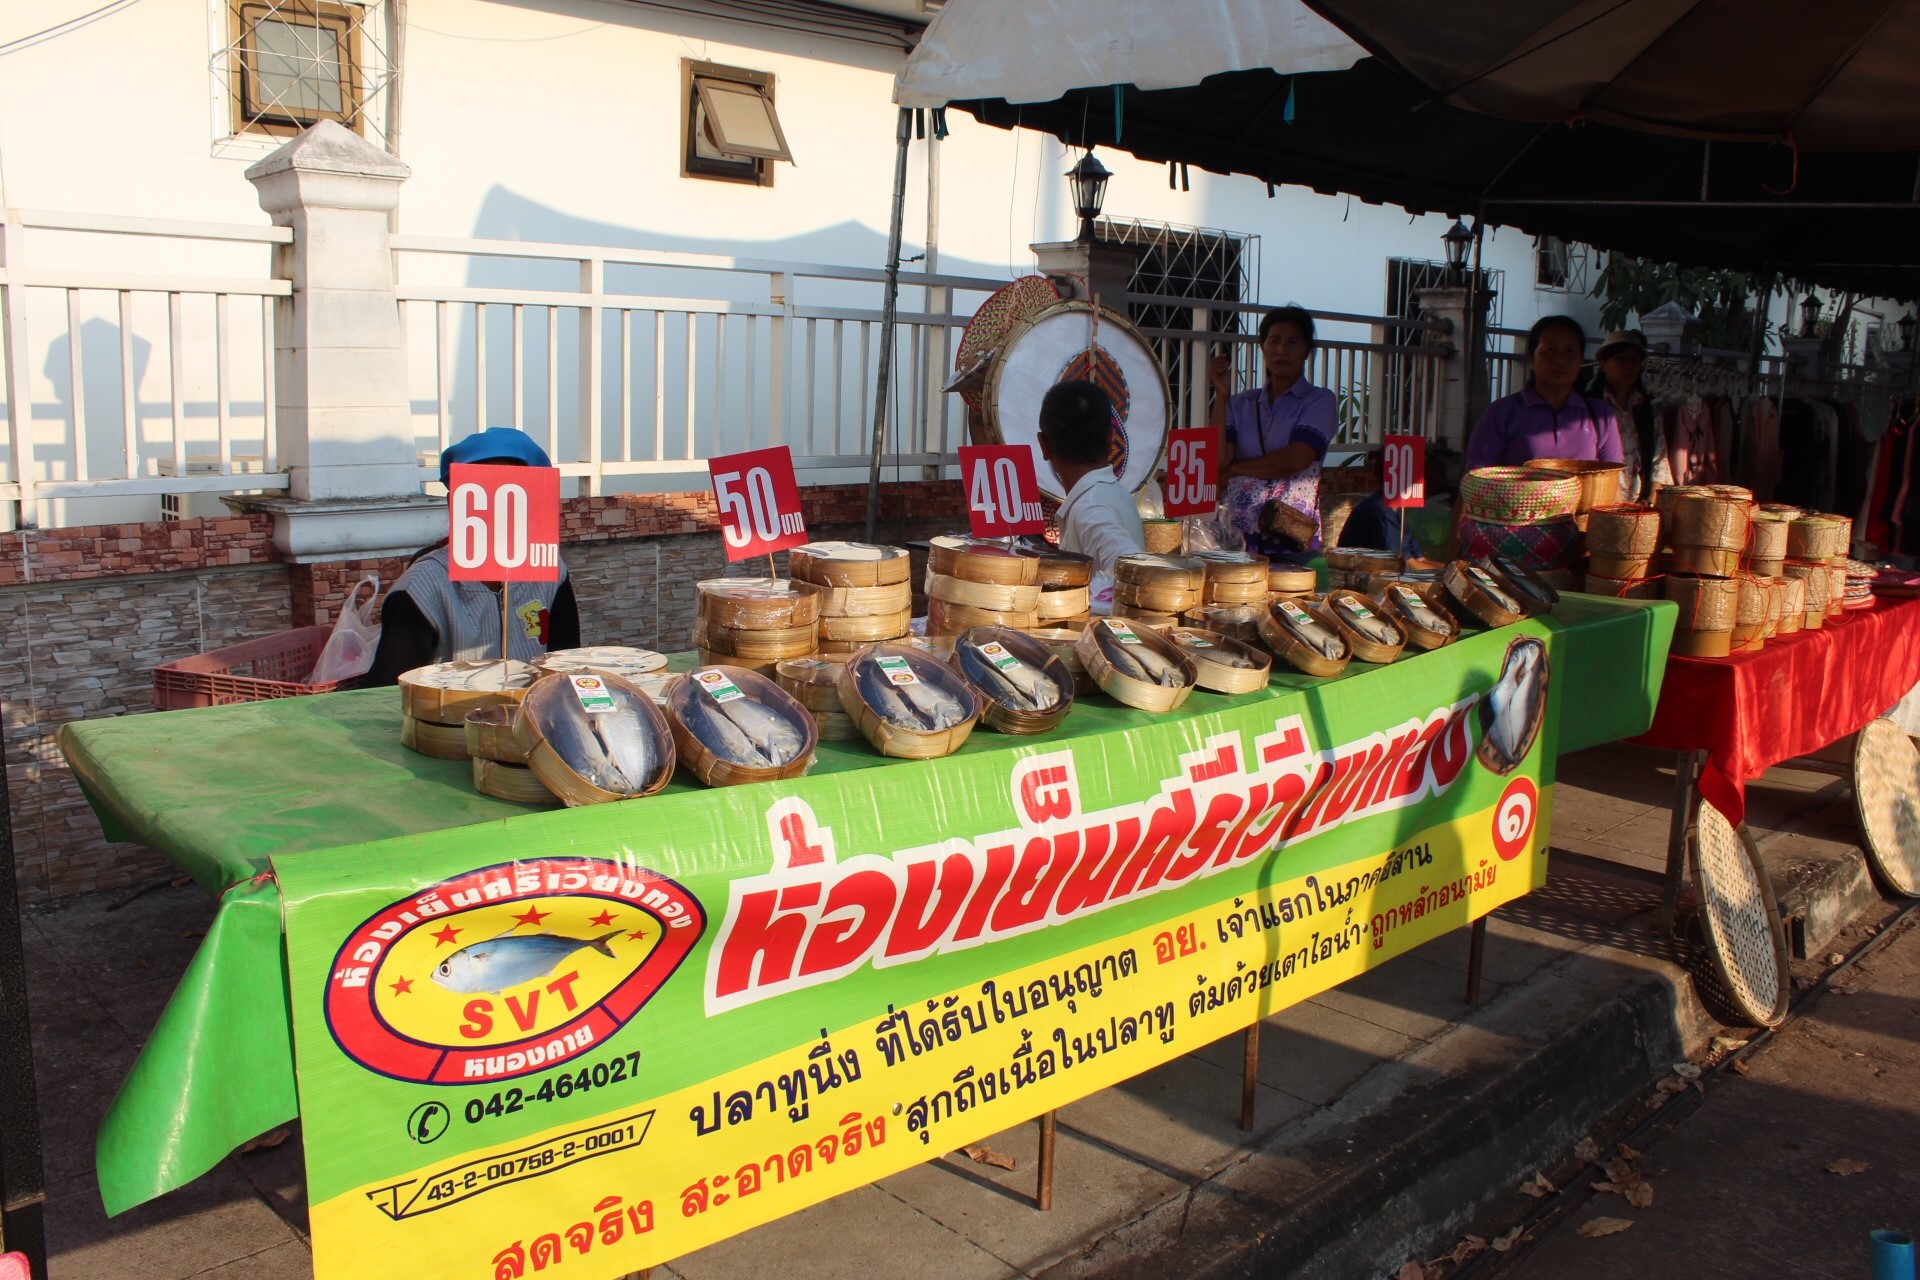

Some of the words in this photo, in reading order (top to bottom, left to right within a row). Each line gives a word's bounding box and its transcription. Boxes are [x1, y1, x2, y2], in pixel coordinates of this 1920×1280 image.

[713, 466, 781, 547] 50
[970, 457, 1023, 524] 40
[1168, 439, 1206, 505] 35
[1383, 443, 1413, 500] 30
[452, 482, 528, 569] 60
[459, 969, 580, 1039] SVT
[463, 1024, 594, 1078] หนองคาย
[491, 1194, 655, 1280] สดจริง
[680, 1111, 887, 1218] สะอาดจริง
[1370, 859, 1497, 950] ถูกหลักอนามัย
[688, 1027, 862, 1138] ปลาทูนึ่ง
[874, 947, 1138, 1068] ที่ได้รับใบอนุญาต
[464, 1050, 641, 1124] 042-464027
[426, 1124, 635, 1201] 43-2-00758-2-0001
